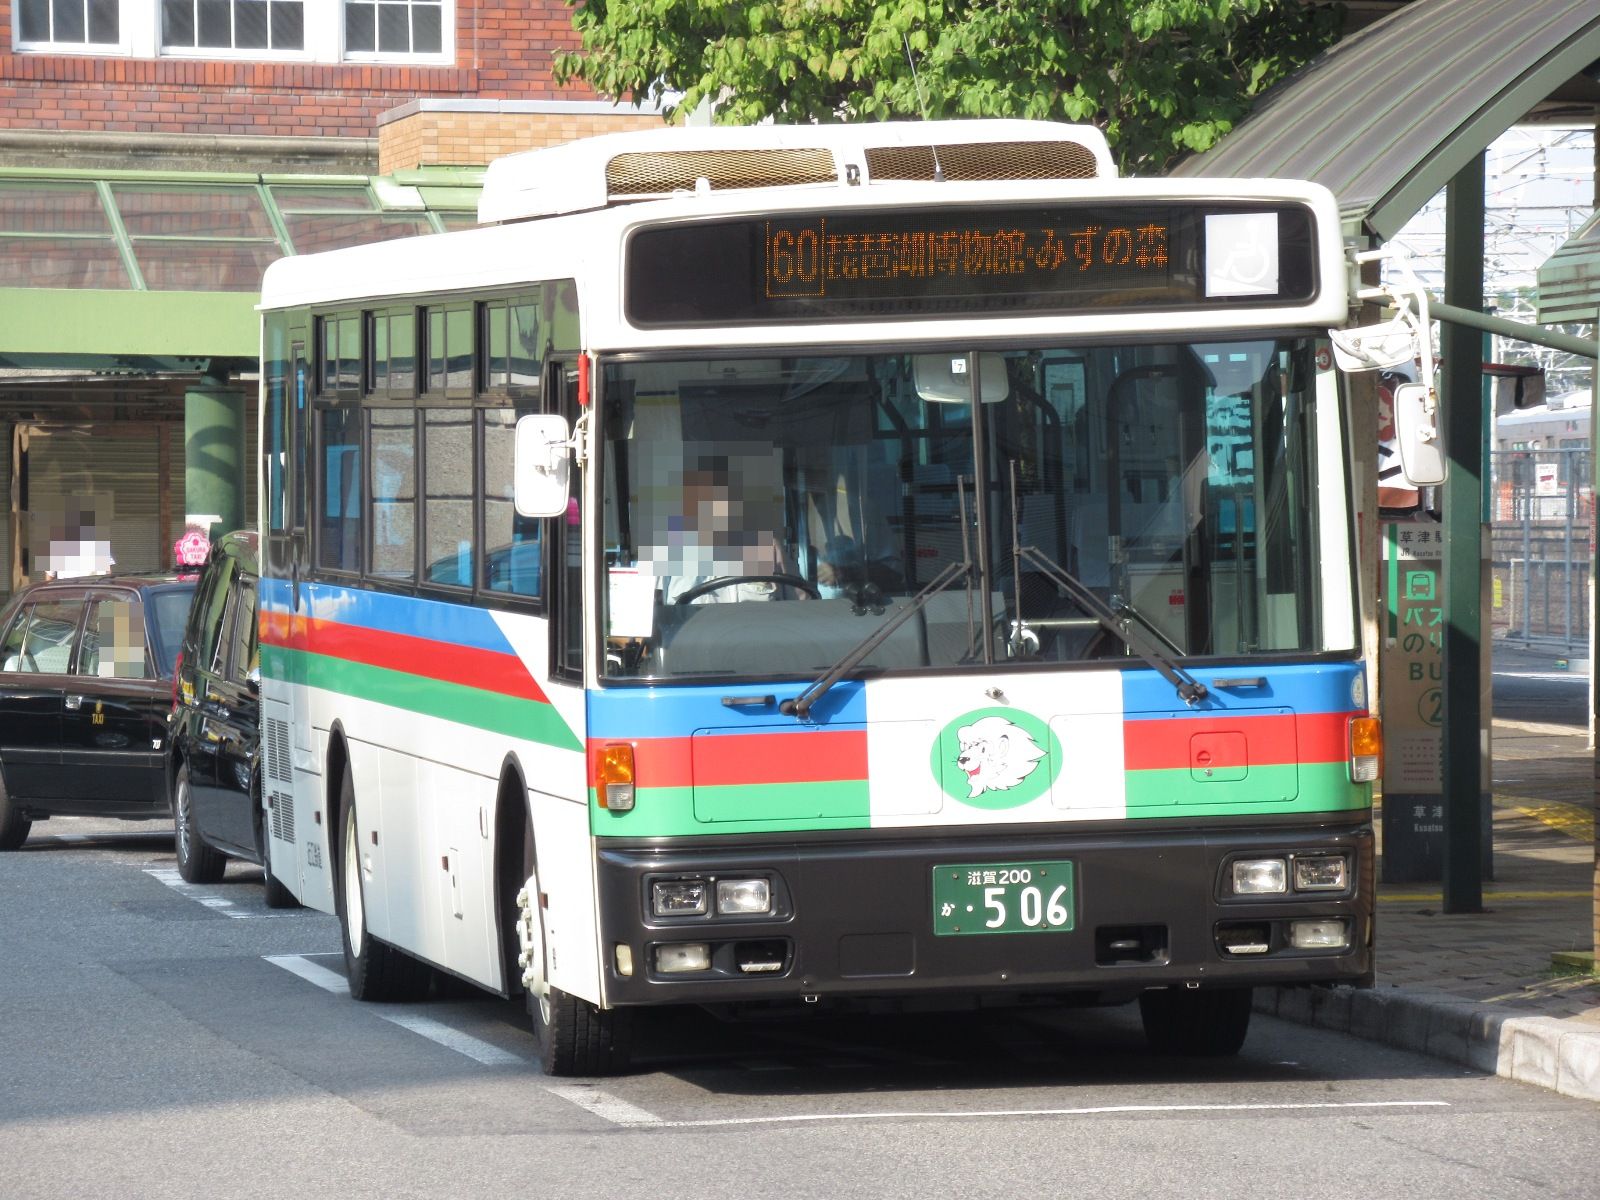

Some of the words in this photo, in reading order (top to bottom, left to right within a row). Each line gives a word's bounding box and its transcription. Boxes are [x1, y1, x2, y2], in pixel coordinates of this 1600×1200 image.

[774, 230, 817, 283] 60
[1401, 547, 1410, 557] JR
[1403, 607, 1443, 627] バス
[1402, 632, 1443, 655] のり
[1409, 662, 1443, 681] BU
[91, 713, 104, 725] TAXI
[1413, 805, 1443, 818] 草津
[941, 902, 956, 917] か
